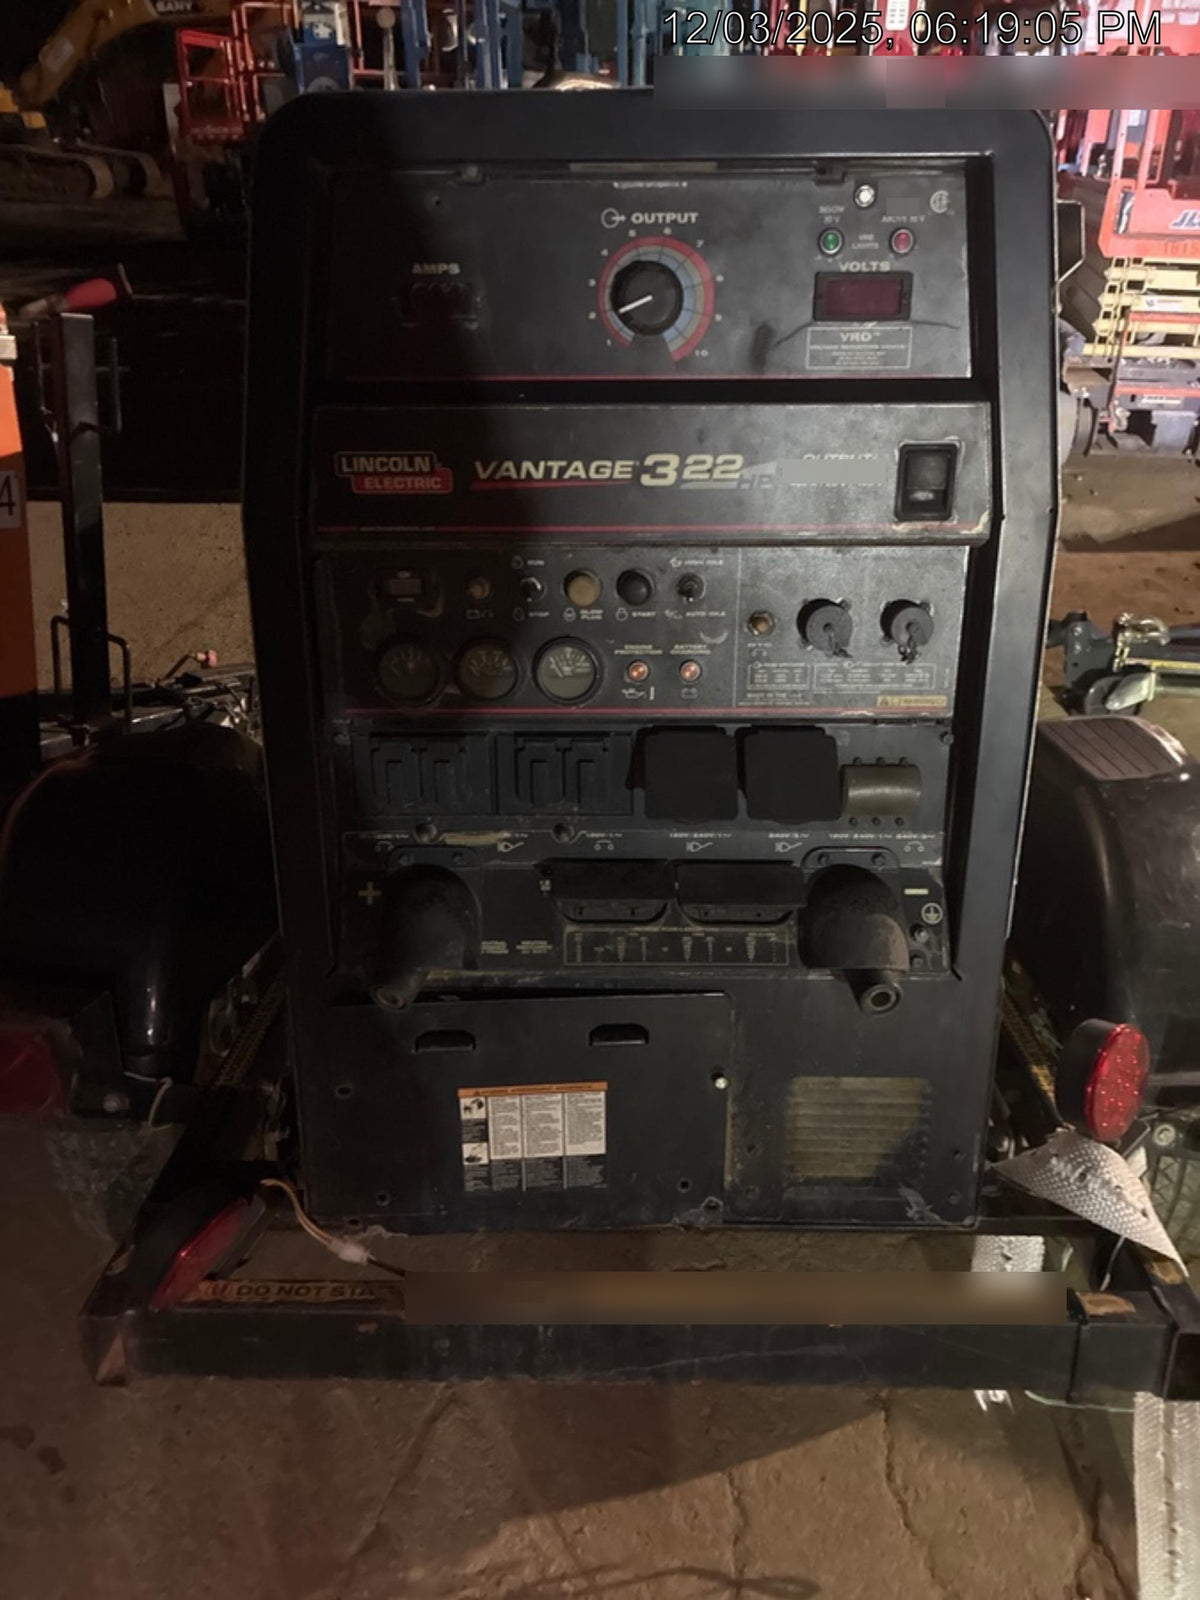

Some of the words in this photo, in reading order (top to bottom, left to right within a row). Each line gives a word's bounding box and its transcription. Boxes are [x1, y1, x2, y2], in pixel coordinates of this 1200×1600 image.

[630, 212, 699, 224] OUTPUT
[1171, 211, 1200, 227] JL
[696, 239, 704, 248] 7
[410, 261, 461, 275] AMPS
[839, 260, 891, 272] VOLTS
[694, 348, 709, 358] 10
[341, 456, 431, 473] LINCOLN
[473, 459, 634, 481] VANTAGE
[638, 452, 744, 488] 322
[363, 476, 443, 490] ELECTRIC
[235, 1284, 270, 1297] DO
[275, 1285, 323, 1298] NOT
